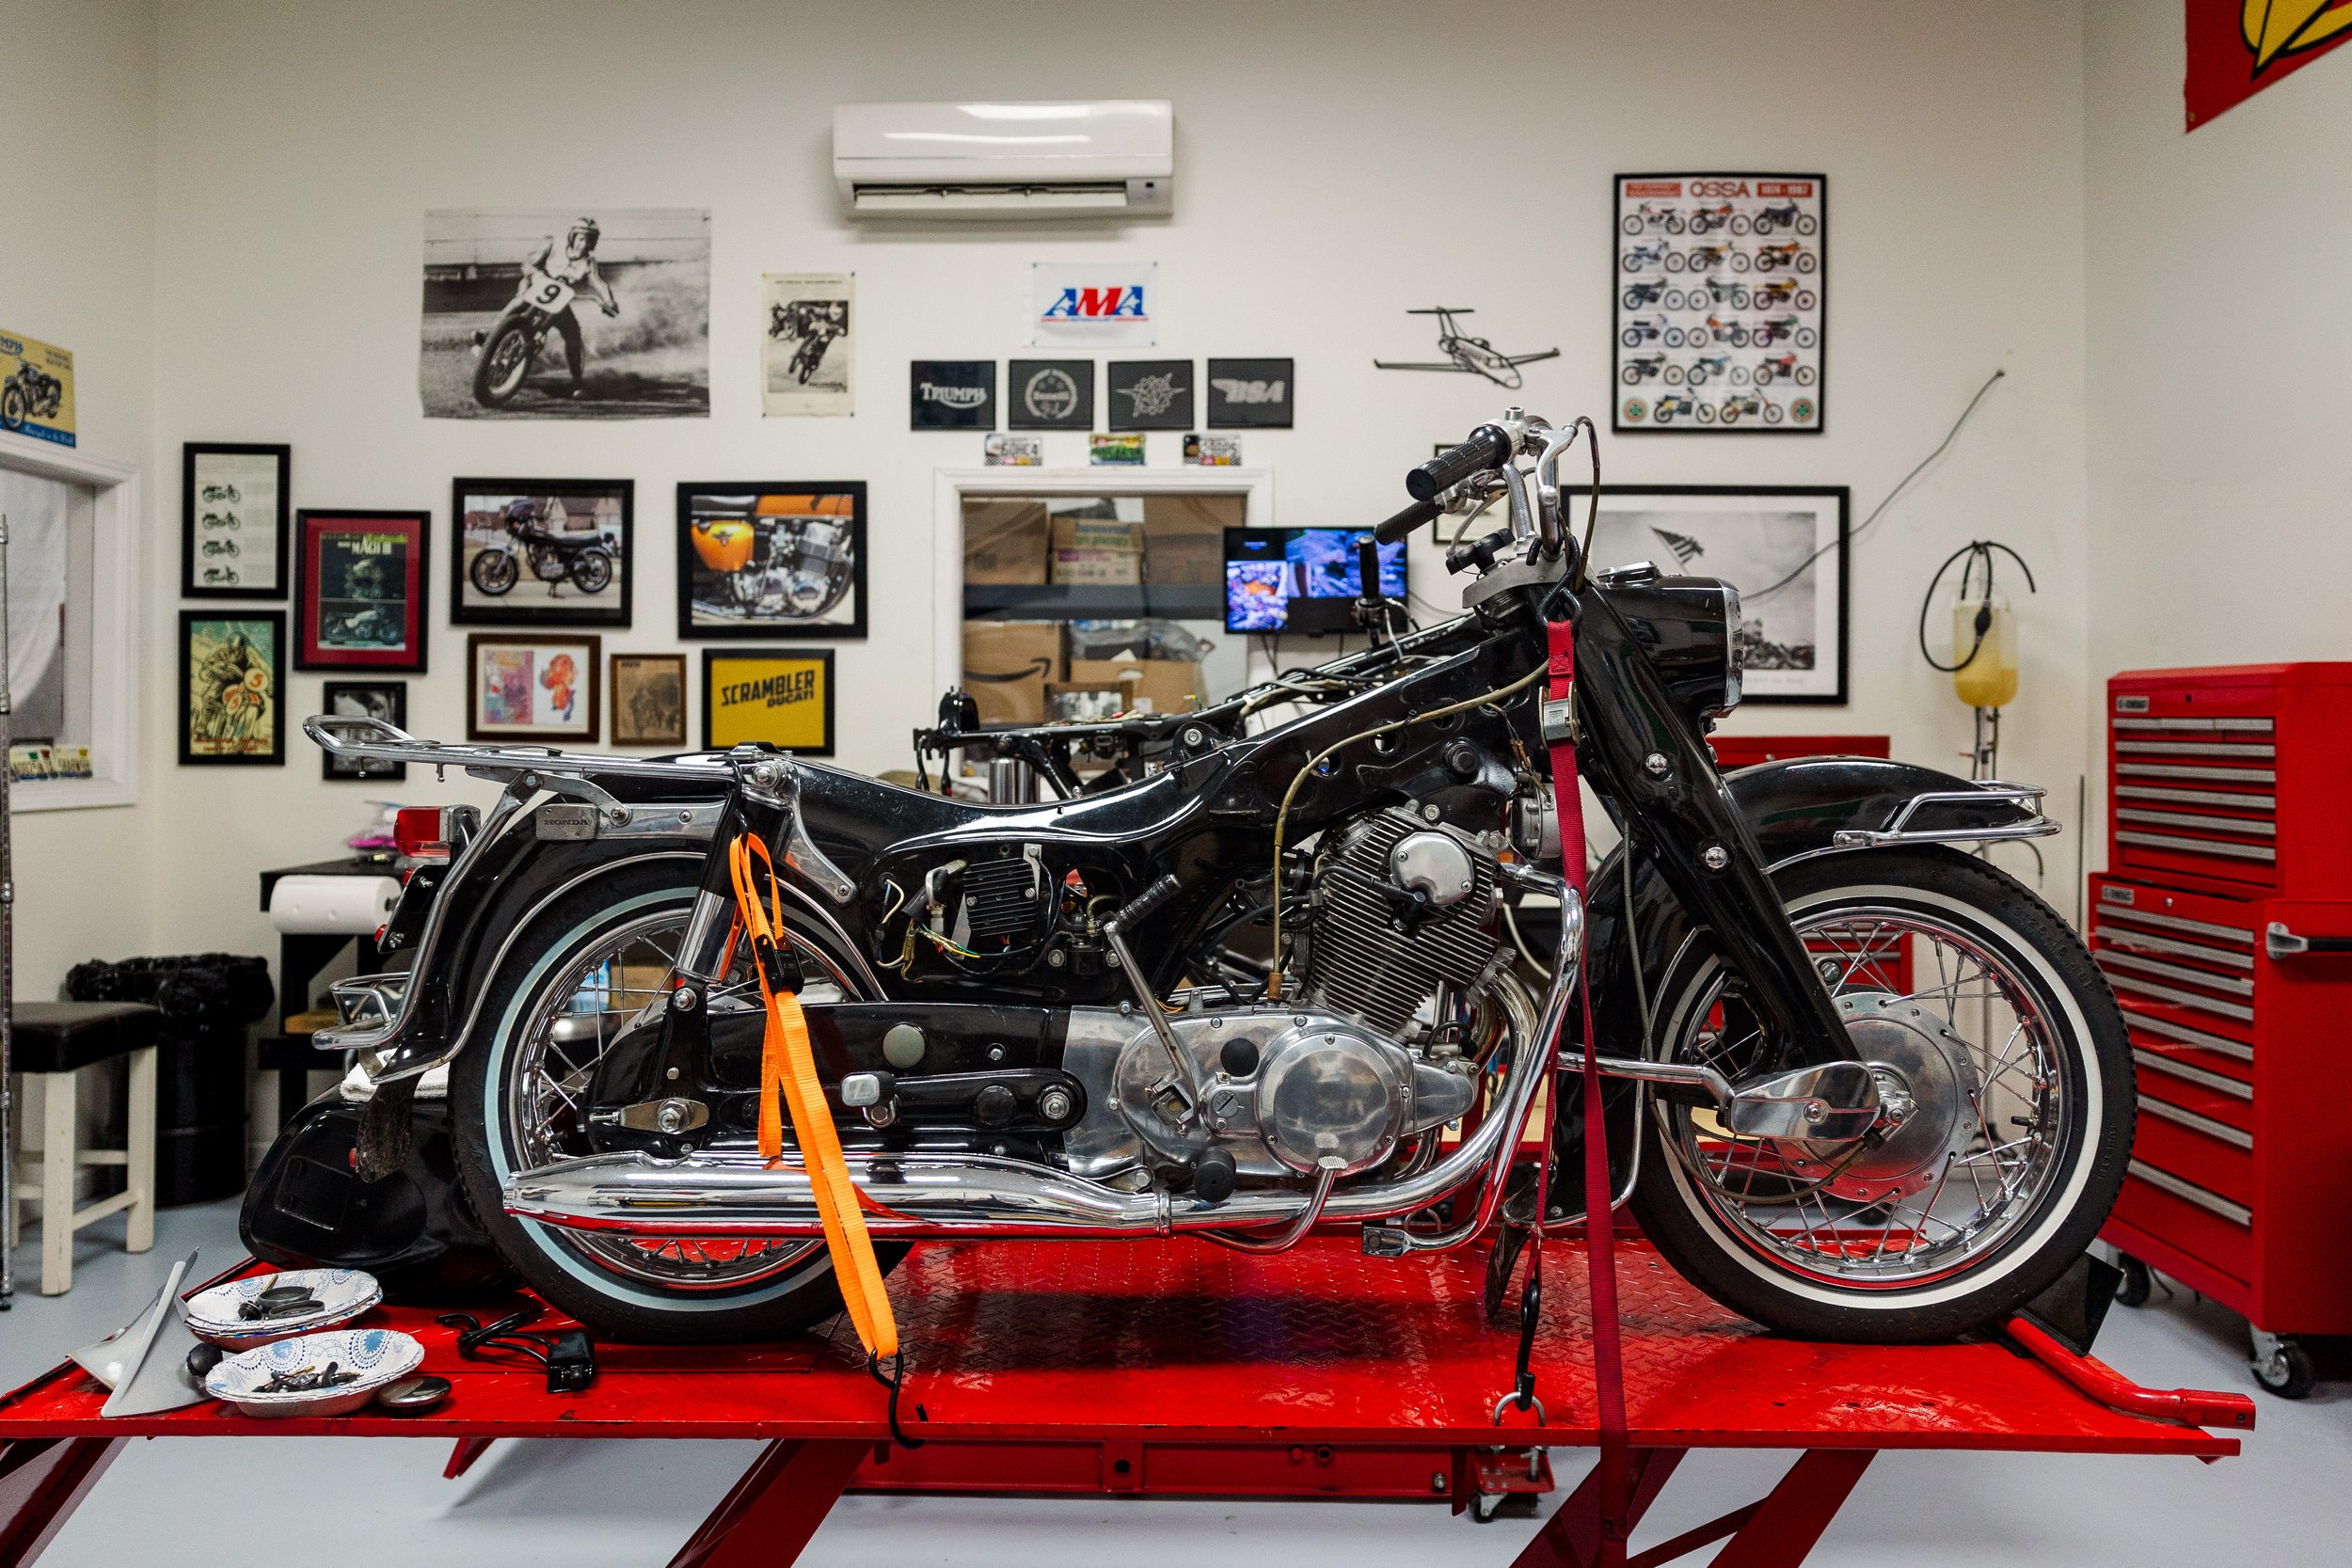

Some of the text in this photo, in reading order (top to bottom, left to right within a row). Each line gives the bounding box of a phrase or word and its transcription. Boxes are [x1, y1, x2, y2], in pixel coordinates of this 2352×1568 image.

[1689, 182, 1751, 198] OSSA
[535, 284, 561, 304] 9
[1041, 285, 1145, 316] AMA
[920, 382, 988, 408] TRIUMPH
[351, 533, 381, 555] MACH
[721, 669, 816, 707] SCRAMBLER
[766, 689, 815, 708] DUCATI
